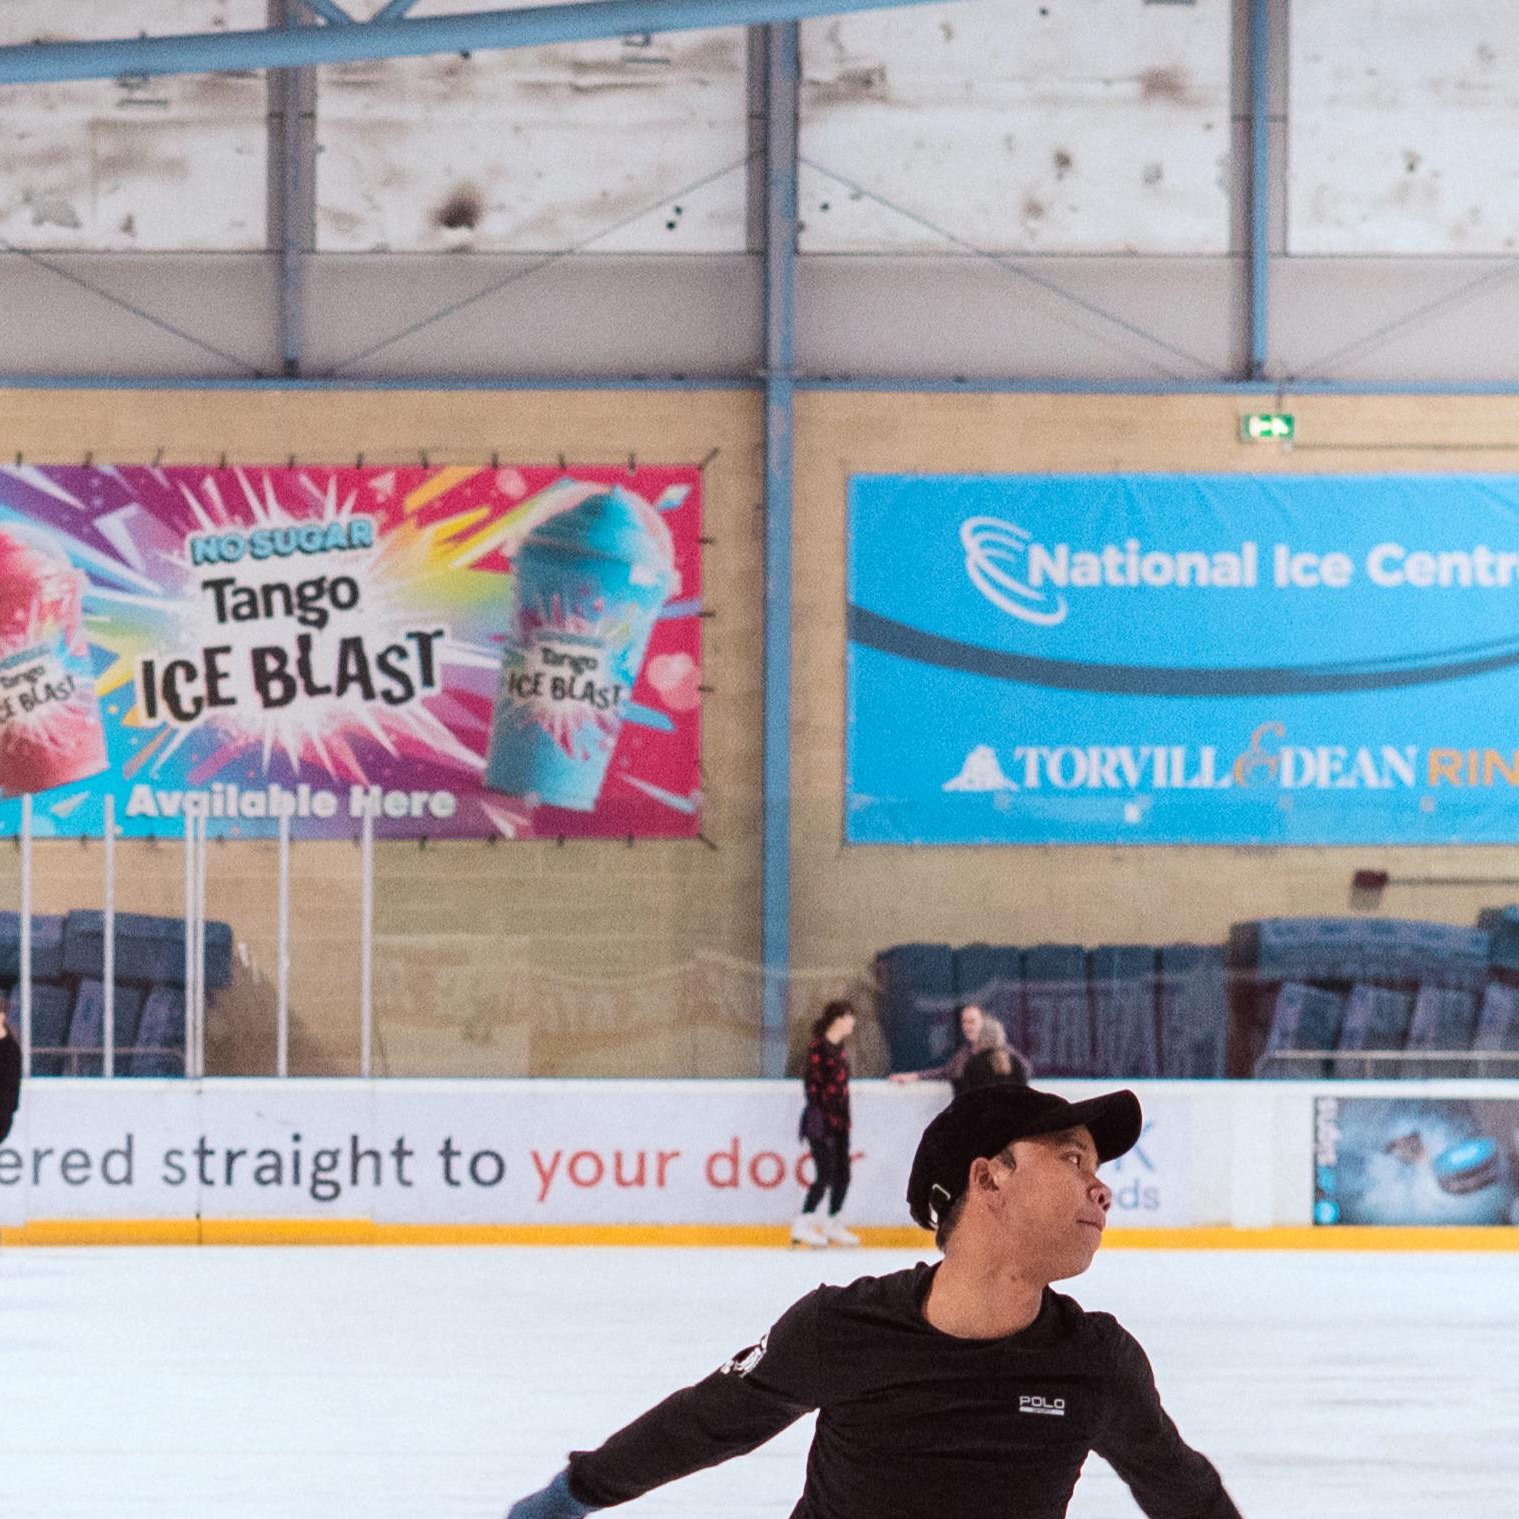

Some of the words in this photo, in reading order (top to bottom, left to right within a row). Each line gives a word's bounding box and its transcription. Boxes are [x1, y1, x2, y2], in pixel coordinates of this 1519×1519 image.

[191, 533, 245, 565] NO
[248, 519, 372, 561] SUGAR
[1028, 538, 1258, 588] National
[1274, 543, 1354, 588] Ice
[201, 575, 360, 630] Tango
[142, 645, 238, 723] ICE
[251, 629, 444, 709] BLAST
[551, 675, 621, 710] BLAST
[1014, 744, 1233, 790] TORVILL
[1283, 745, 1418, 790] DEAN
[126, 782, 338, 819] Available
[350, 785, 458, 819] Here
[162, 1133, 414, 1202] straight
[438, 1136, 506, 1188] to
[531, 1149, 680, 1202] your
[1019, 1395, 1065, 1409] POLO
